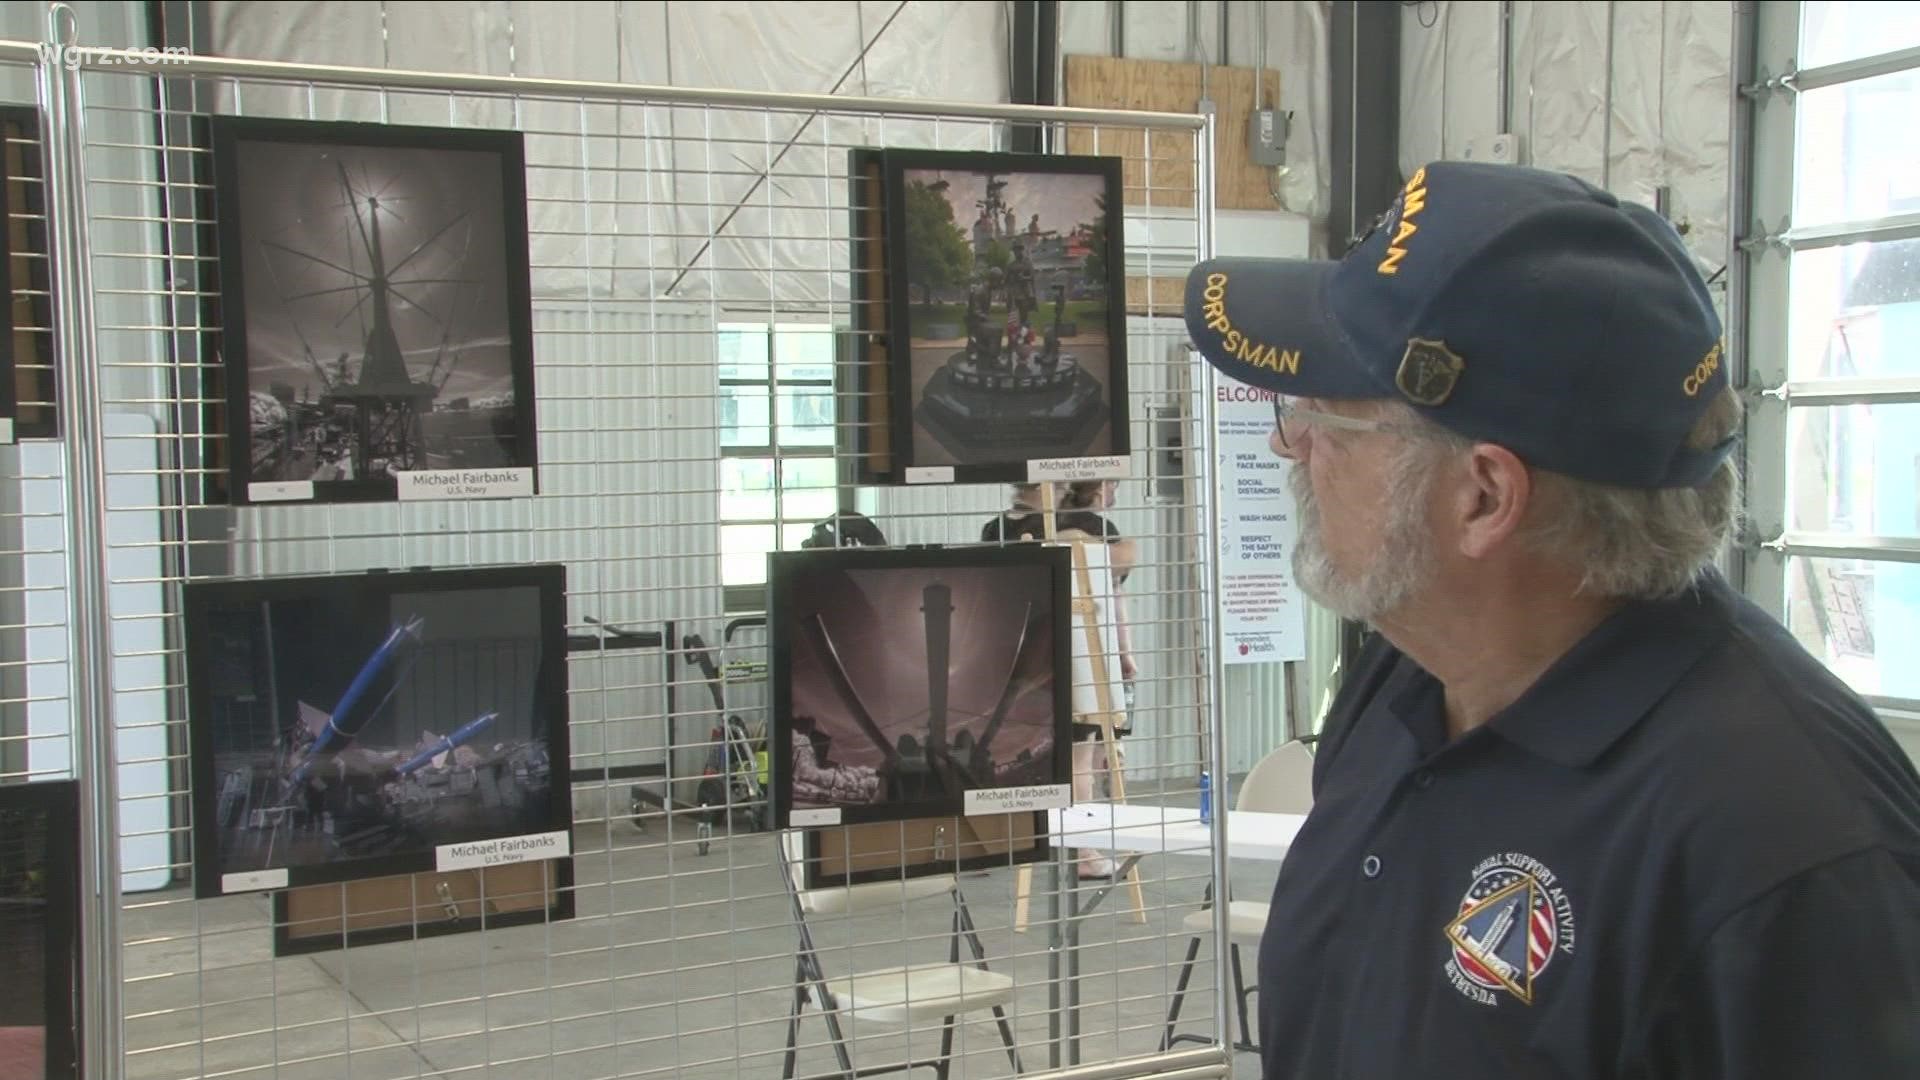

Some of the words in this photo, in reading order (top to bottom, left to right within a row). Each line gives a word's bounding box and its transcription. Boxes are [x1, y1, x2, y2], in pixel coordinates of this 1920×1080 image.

[1203, 273, 1301, 375] CORPSMAN
[1217, 387, 1277, 402] ELCOM
[1039, 459, 1075, 471] Michael
[1077, 457, 1121, 469] Fairbanks
[1236, 462, 1255, 470] FACE
[1256, 462, 1281, 470] MASKS
[412, 473, 459, 486] Michael
[462, 471, 520, 484] Fairbanks
[1064, 470, 1078, 479] U.S.
[1078, 470, 1096, 478] Navy
[1237, 479, 1263, 487] SOCIAL
[447, 486, 462, 495] U.S.
[464, 486, 488, 495] Navy
[1238, 487, 1281, 495] DISTANCING
[1261, 514, 1287, 522] HANDS
[1241, 543, 1255, 551] THE
[1241, 552, 1252, 560] OF
[1252, 552, 1281, 560] OTHERS
[975, 789, 1013, 801] Michael
[1015, 786, 1060, 799] Fairbanks
[1001, 800, 1015, 808] U.S.
[1015, 799, 1033, 808] Navy
[451, 841, 498, 858] Michael
[500, 836, 556, 853] Fairbanks
[484, 854, 501, 864] U.S.
[502, 852, 524, 862] Navy
[1505, 852, 1558, 887] SUPPORT
[1550, 887, 1576, 954] ACTIVITY
[1444, 959, 1498, 1007] BETHESDA
